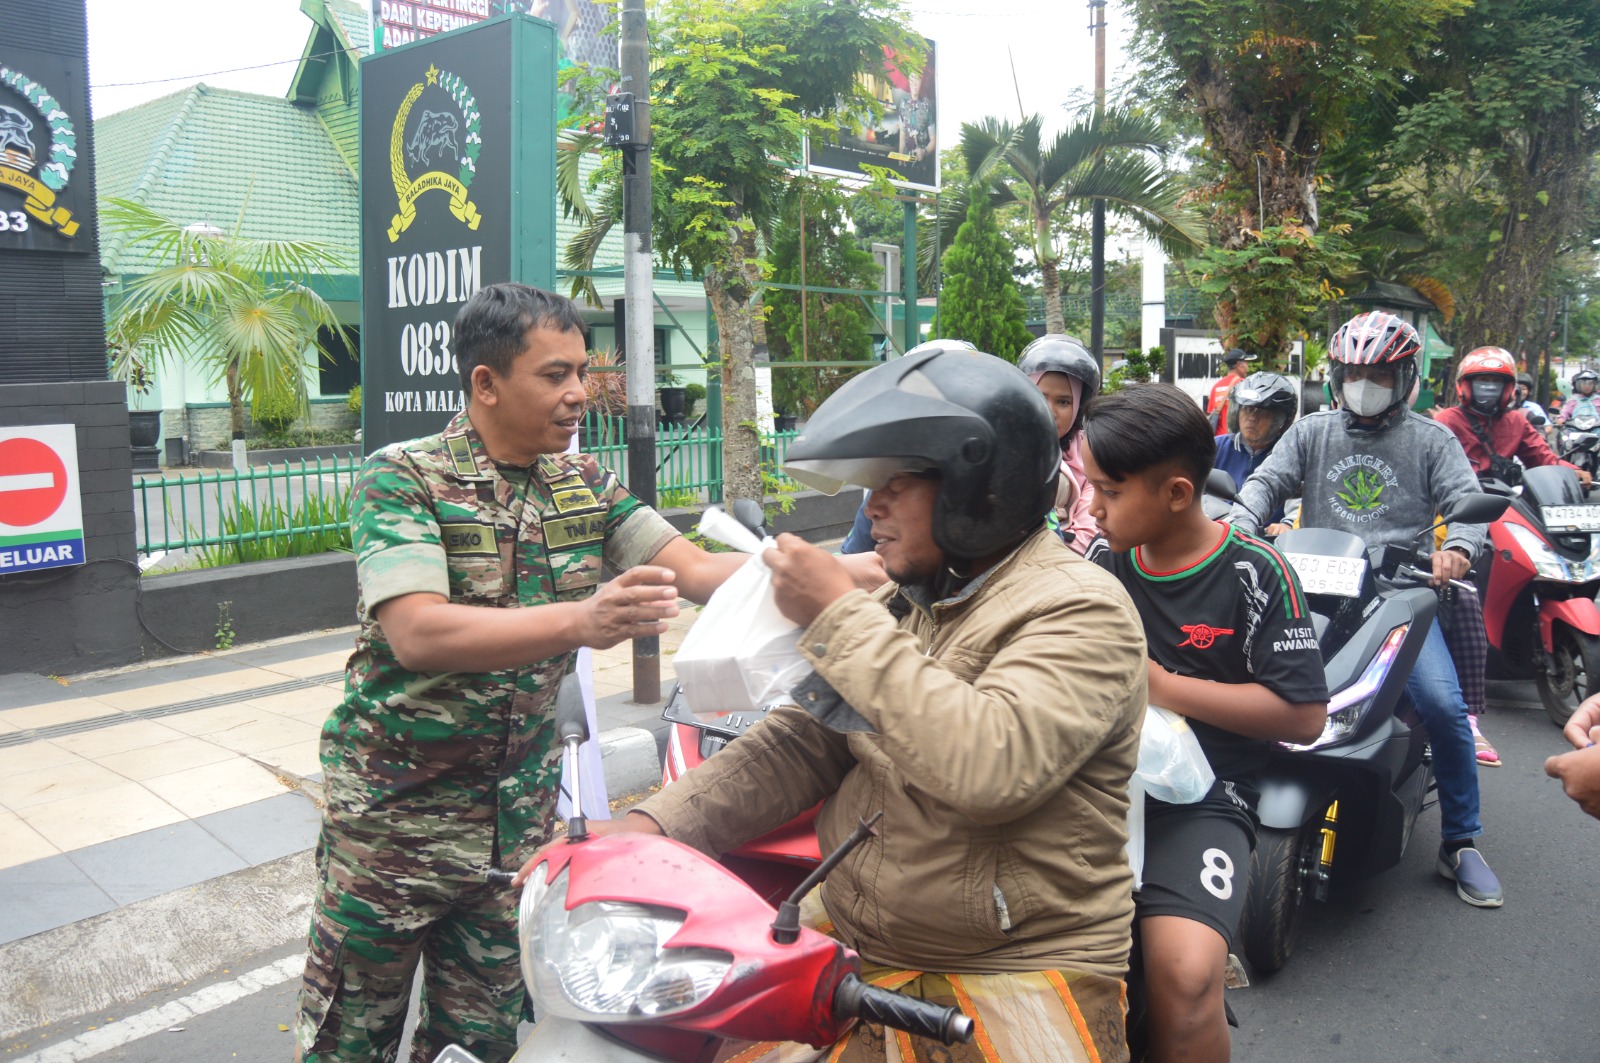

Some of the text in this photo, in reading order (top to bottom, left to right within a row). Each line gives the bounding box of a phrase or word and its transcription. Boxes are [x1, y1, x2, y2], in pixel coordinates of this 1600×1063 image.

[381, 1, 413, 25] DARI
[8, 174, 36, 191] JAYA
[405, 176, 460, 203] BALADHIKA JAYA
[387, 245, 483, 308] KODIM
[384, 391, 422, 412] KOTA
[1326, 454, 1399, 489] SNEIGERY
[1328, 496, 1389, 523] HERBALICIOUS
[450, 532, 482, 547] EKO
[564, 522, 588, 539] TNI
[0, 544, 73, 567] ELUAR
[1284, 627, 1312, 639] VISIT
[704, 734, 730, 744] HOND
[1200, 848, 1234, 900] 8
